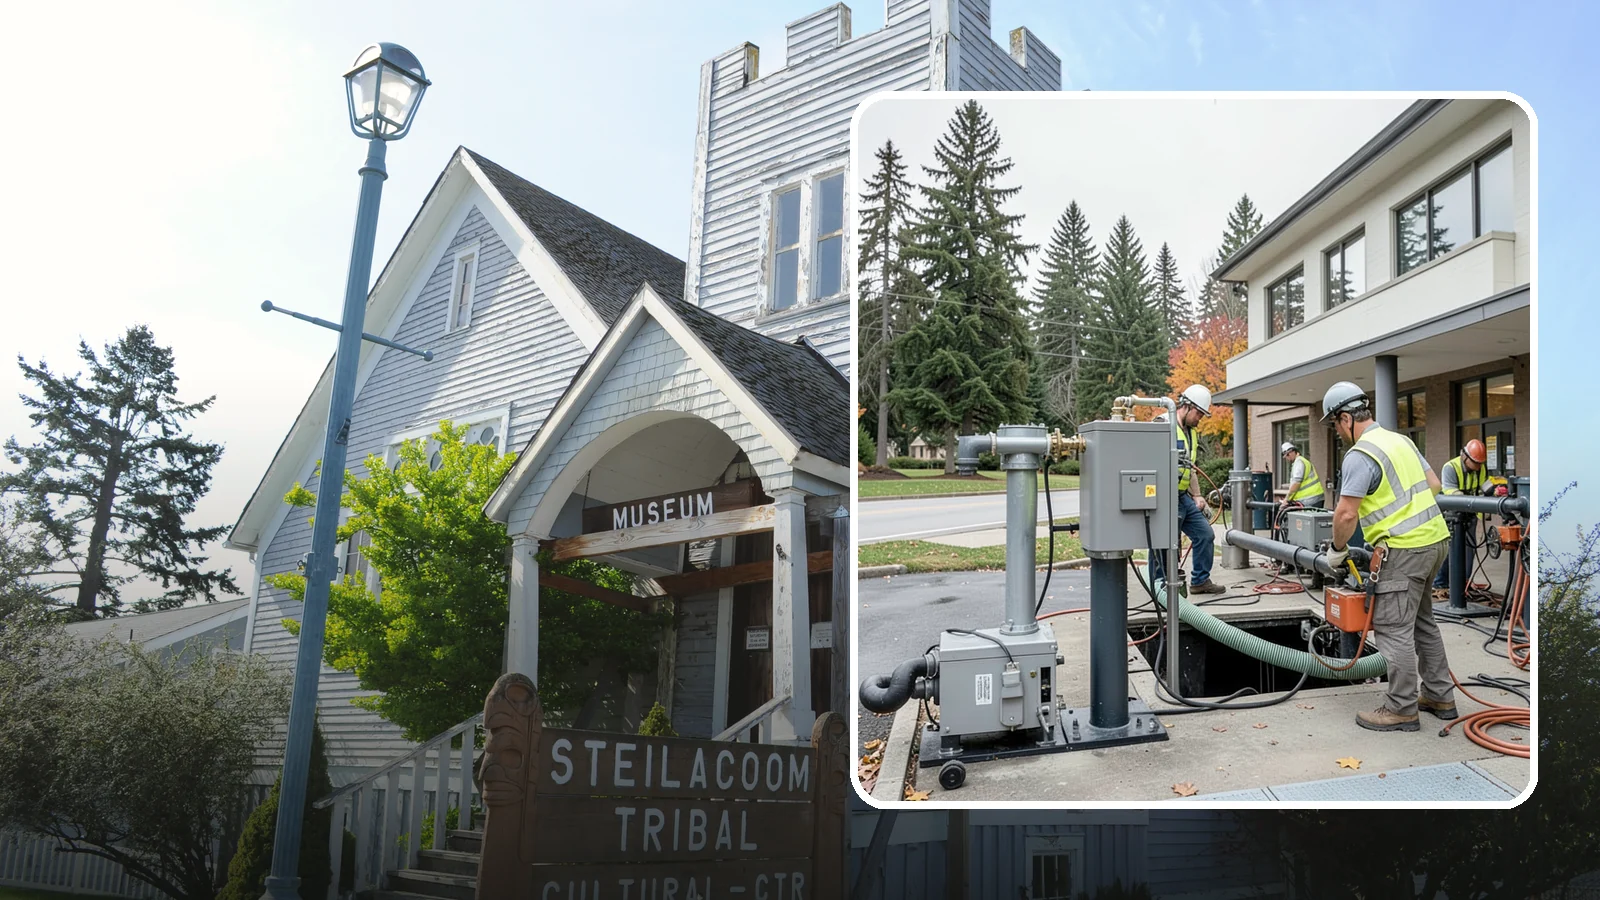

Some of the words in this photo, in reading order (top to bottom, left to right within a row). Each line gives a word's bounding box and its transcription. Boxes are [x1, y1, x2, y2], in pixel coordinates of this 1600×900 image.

[613, 491, 713, 530] MUSEUM
[550, 738, 810, 793] STEILACOOM
[613, 806, 758, 852] TRIBAL
